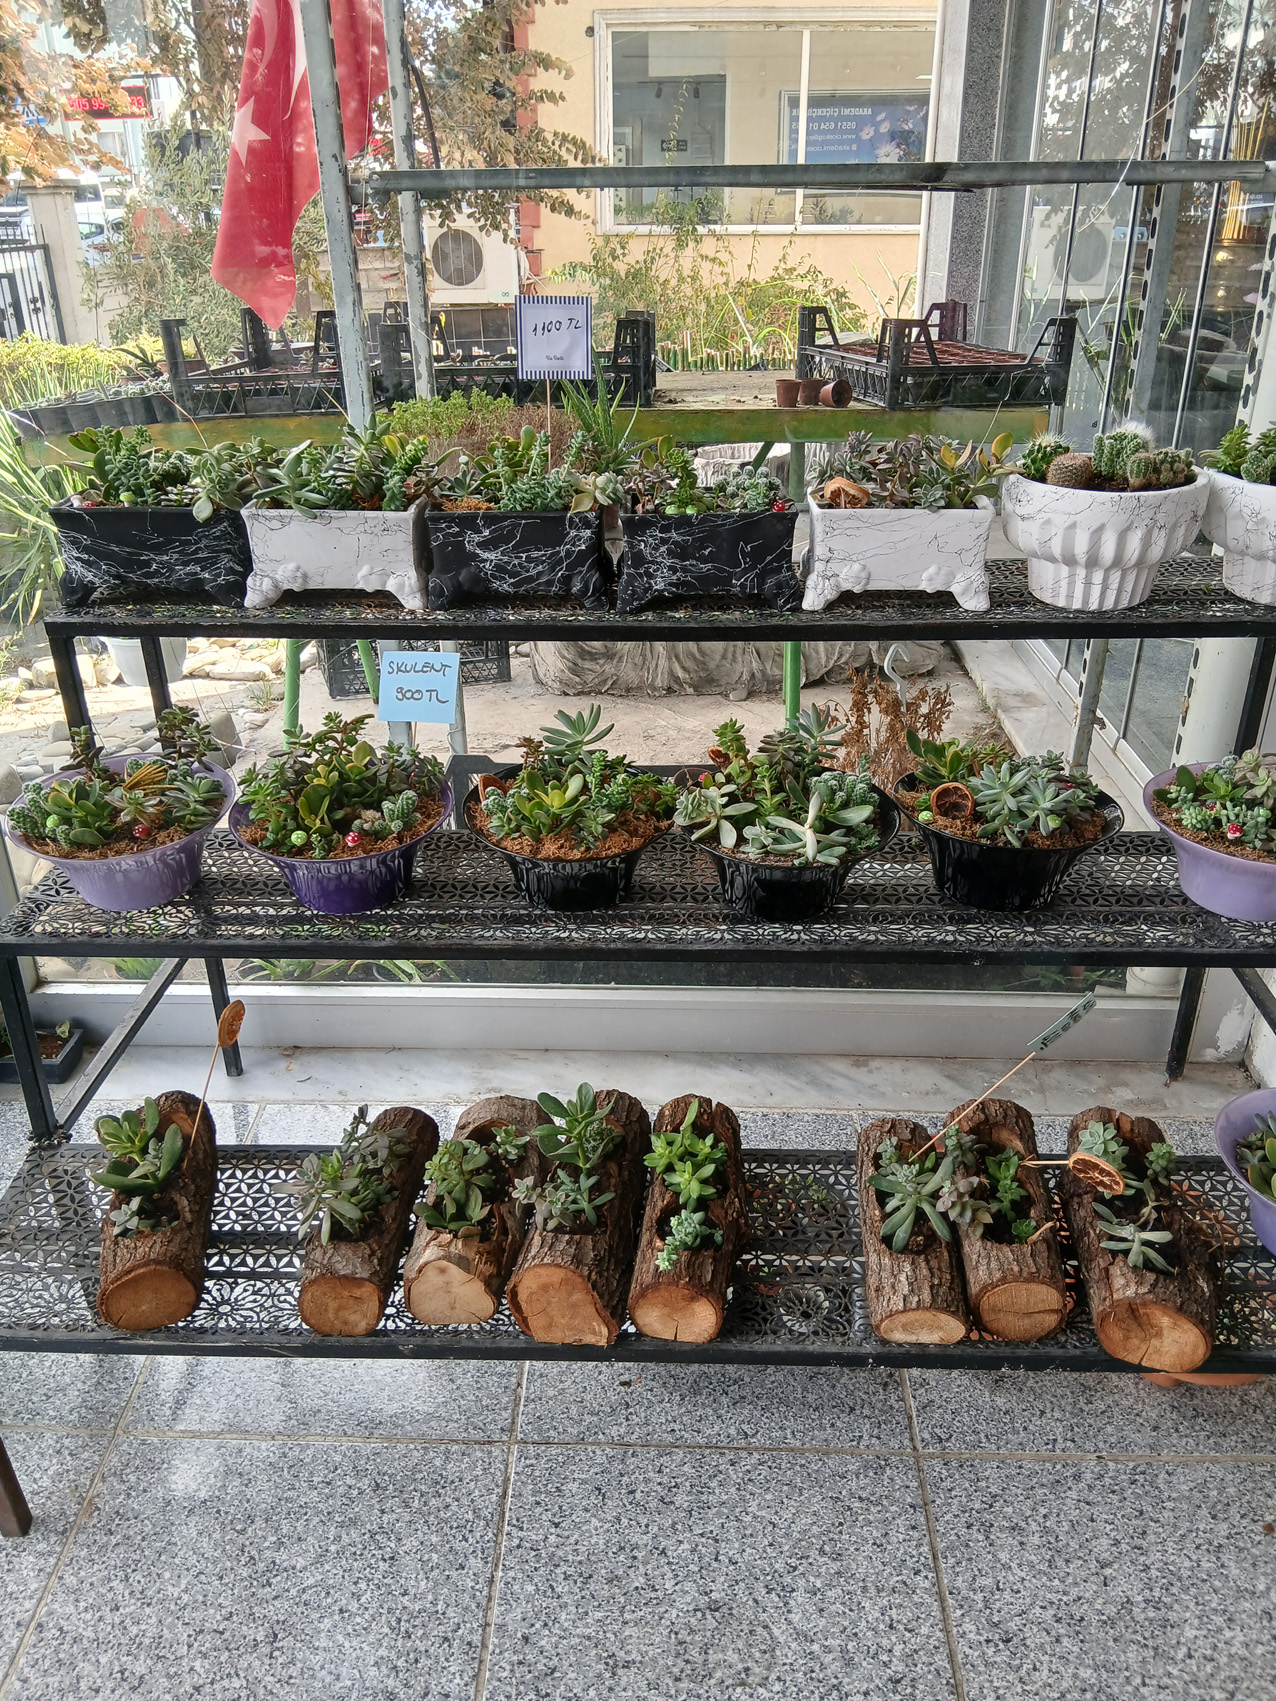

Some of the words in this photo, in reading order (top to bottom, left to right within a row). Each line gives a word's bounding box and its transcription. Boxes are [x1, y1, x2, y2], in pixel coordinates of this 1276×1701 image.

[532, 320, 562, 336] 1100
[567, 318, 582, 330] TL
[387, 660, 452, 677] SKULENT
